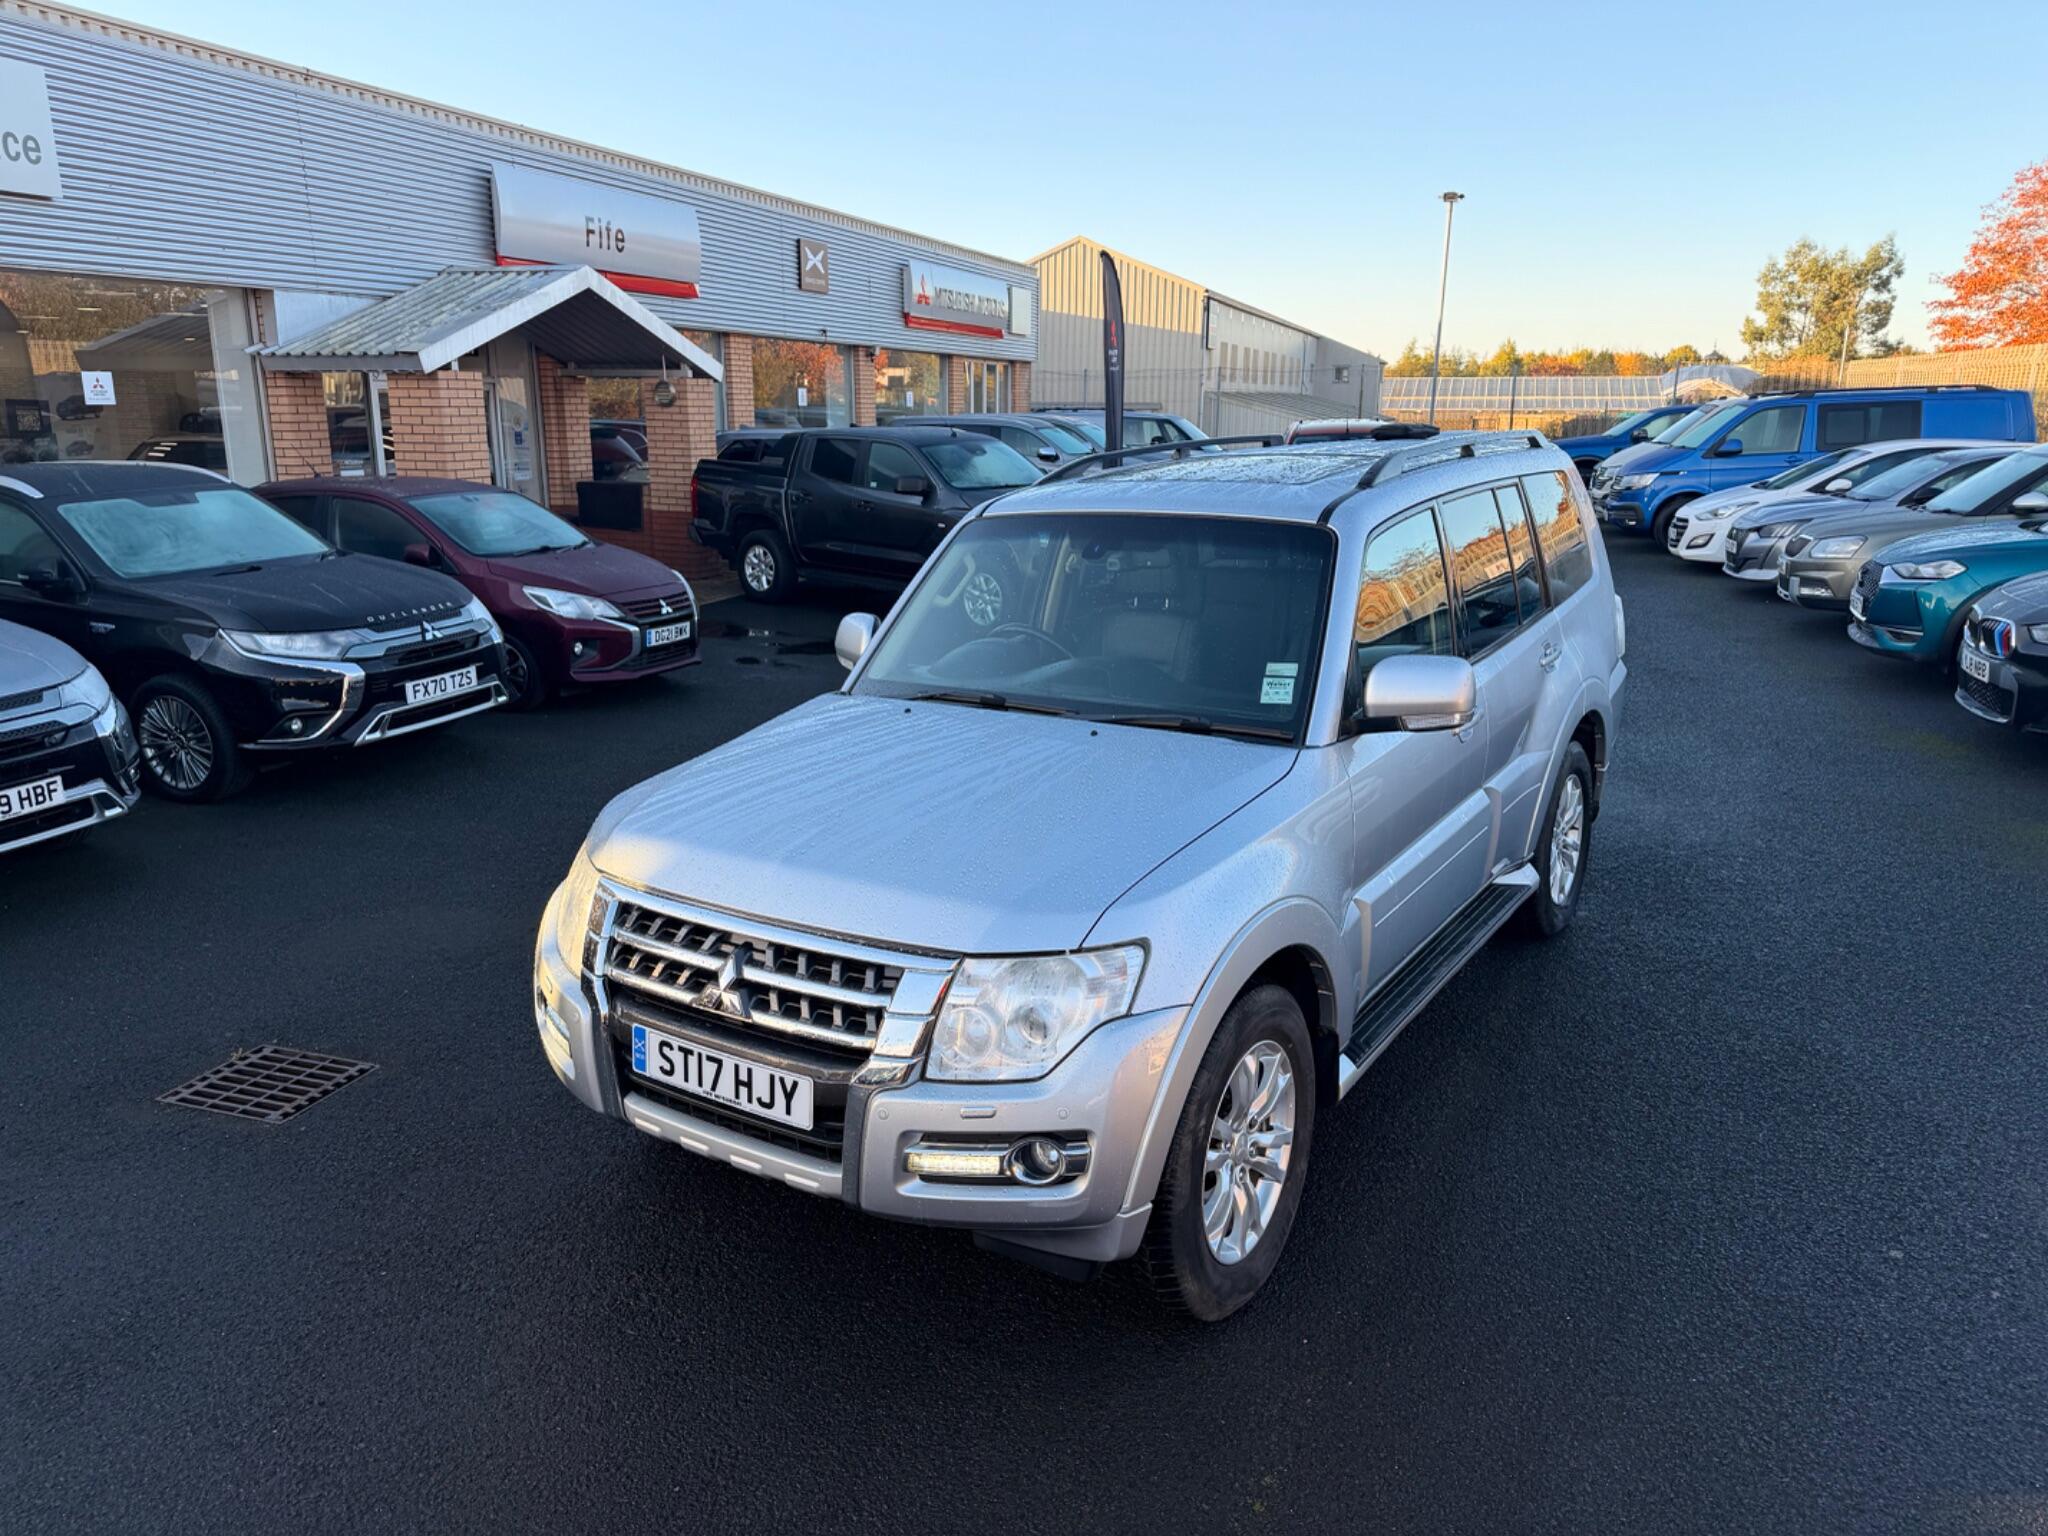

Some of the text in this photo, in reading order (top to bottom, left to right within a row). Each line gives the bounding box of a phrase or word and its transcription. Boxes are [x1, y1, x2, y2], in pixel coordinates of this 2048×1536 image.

[0, 131, 42, 165] ce
[585, 216, 625, 253] Fife
[366, 601, 453, 623] OUTLANDER
[412, 670, 473, 700] FX70 TZS
[17, 780, 58, 810] HBF
[658, 1040, 799, 1117] ST17 HJY
